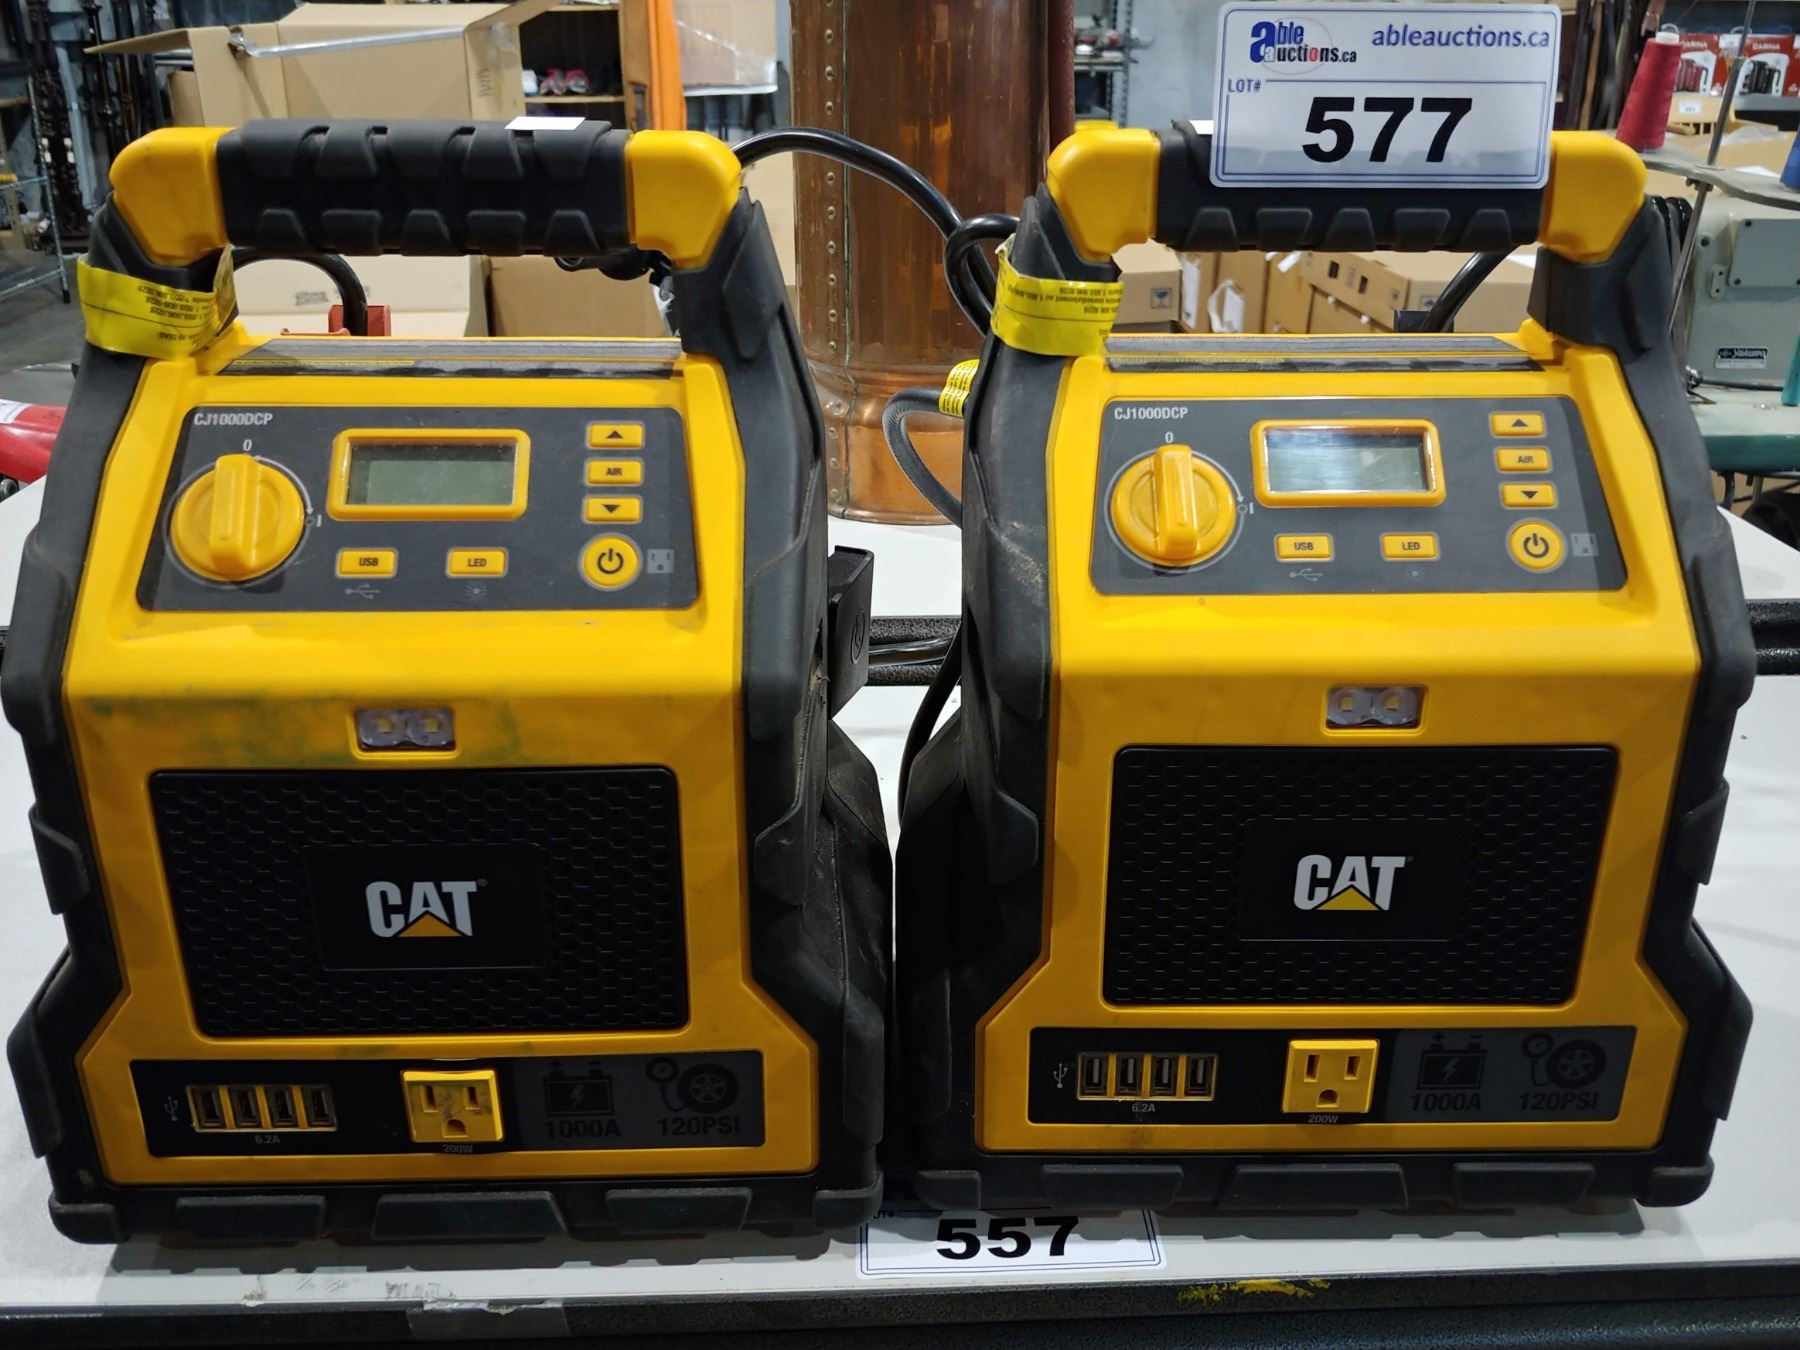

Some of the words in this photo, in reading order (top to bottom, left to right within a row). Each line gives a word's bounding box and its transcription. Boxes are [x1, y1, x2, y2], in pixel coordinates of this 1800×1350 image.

[1372, 24, 1550, 48] ableauctions.ca
[1227, 79, 1262, 93] LOT#
[1302, 96, 1473, 163] 577
[193, 412, 273, 426] CJ1000DCP
[1113, 407, 1188, 420] CJ1000DCP
[1516, 454, 1535, 465] AIR
[605, 466, 623, 477] AIR
[1294, 541, 1315, 551] USB
[1401, 541, 1421, 552] LED
[358, 557, 379, 567] USB
[467, 557, 488, 568] LED
[1410, 1093, 1482, 1112] 1000A
[1519, 1091, 1599, 1111] 120PSI
[1131, 1102, 1156, 1113] 6.2A
[1308, 1114, 1339, 1124] 200W
[544, 1119, 622, 1139] 1000A
[656, 1115, 741, 1137] 120PSI
[254, 1134, 281, 1145] 6.2A
[442, 1143, 474, 1154] 200W
[936, 1215, 1079, 1260] 557
